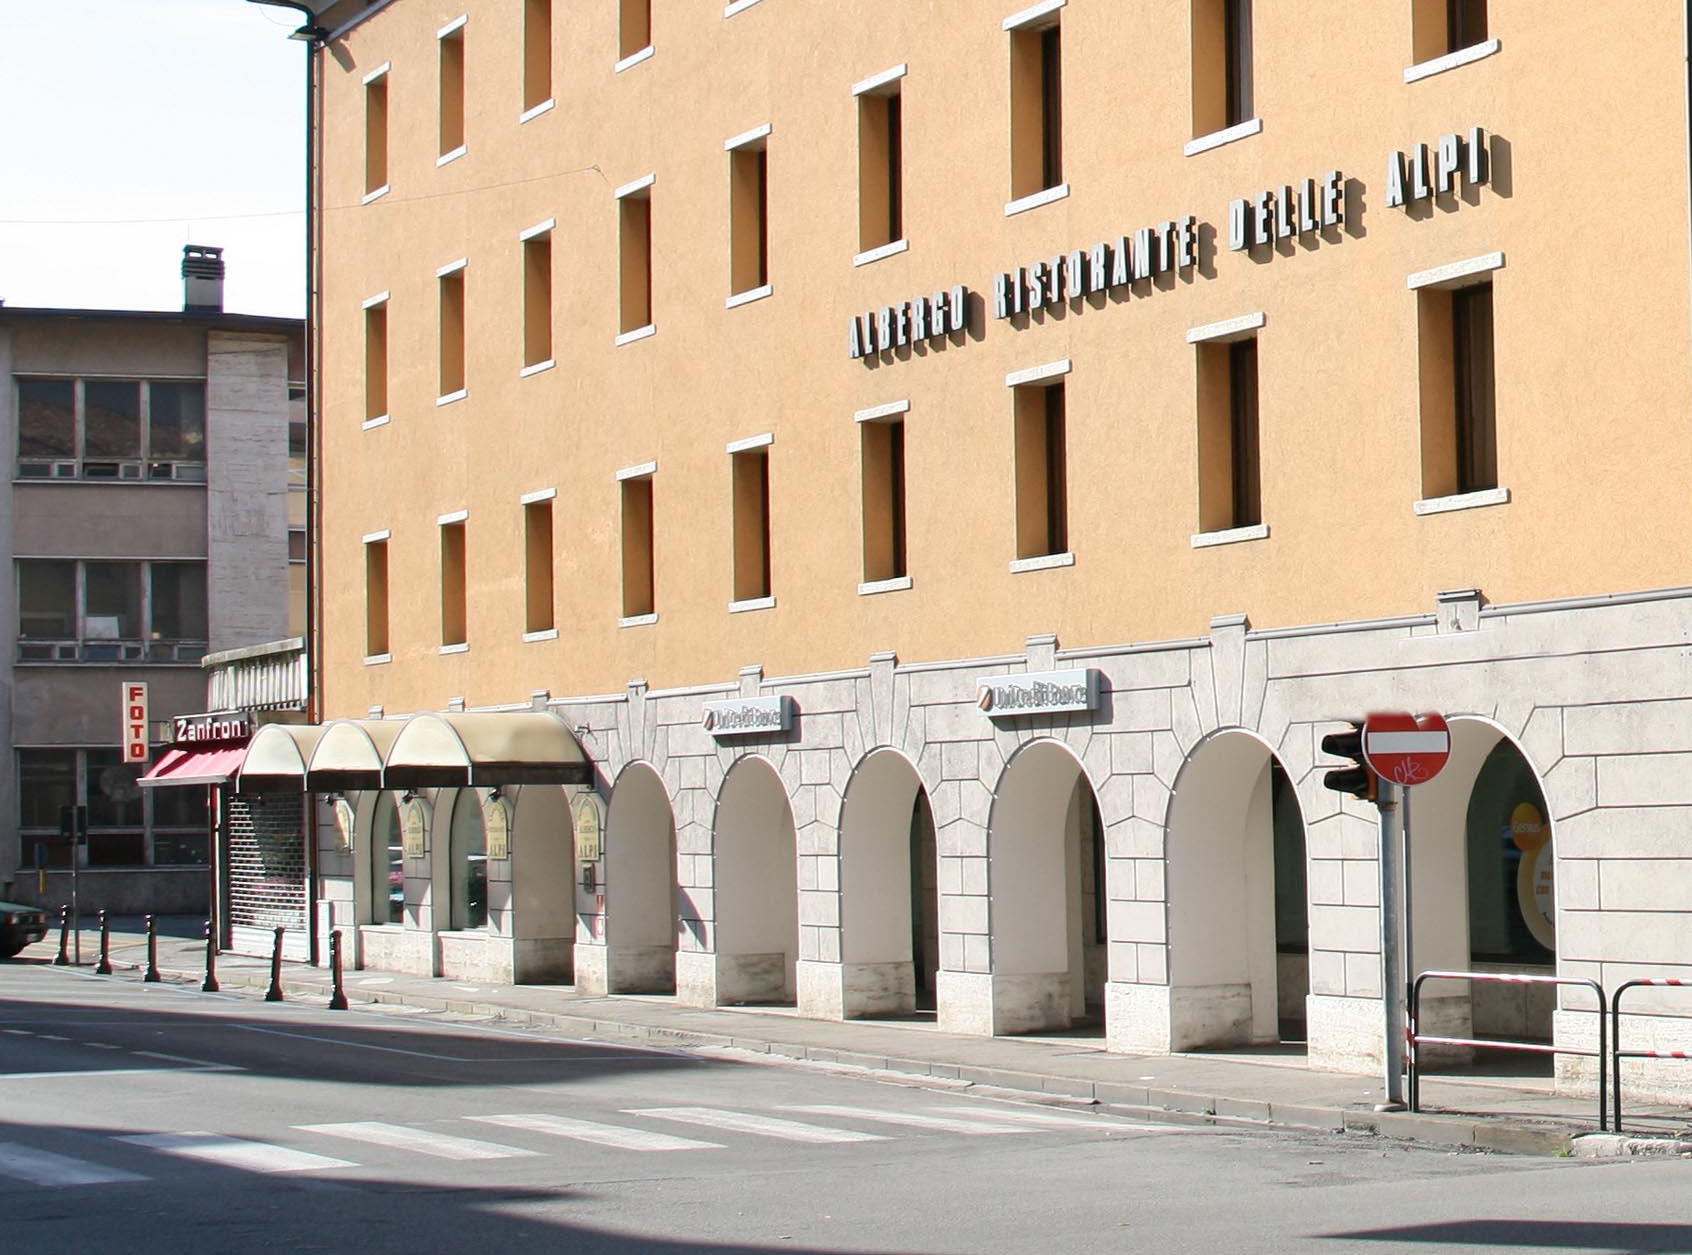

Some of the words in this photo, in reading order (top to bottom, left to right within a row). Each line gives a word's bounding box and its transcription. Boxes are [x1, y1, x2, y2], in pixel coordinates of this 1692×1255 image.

[848, 284, 969, 359] ALBERGO
[992, 215, 1197, 320] RISTORANTE
[1227, 170, 1345, 252] DELLE
[1384, 127, 1489, 208] ALPI
[129, 687, 145, 757] FOTO
